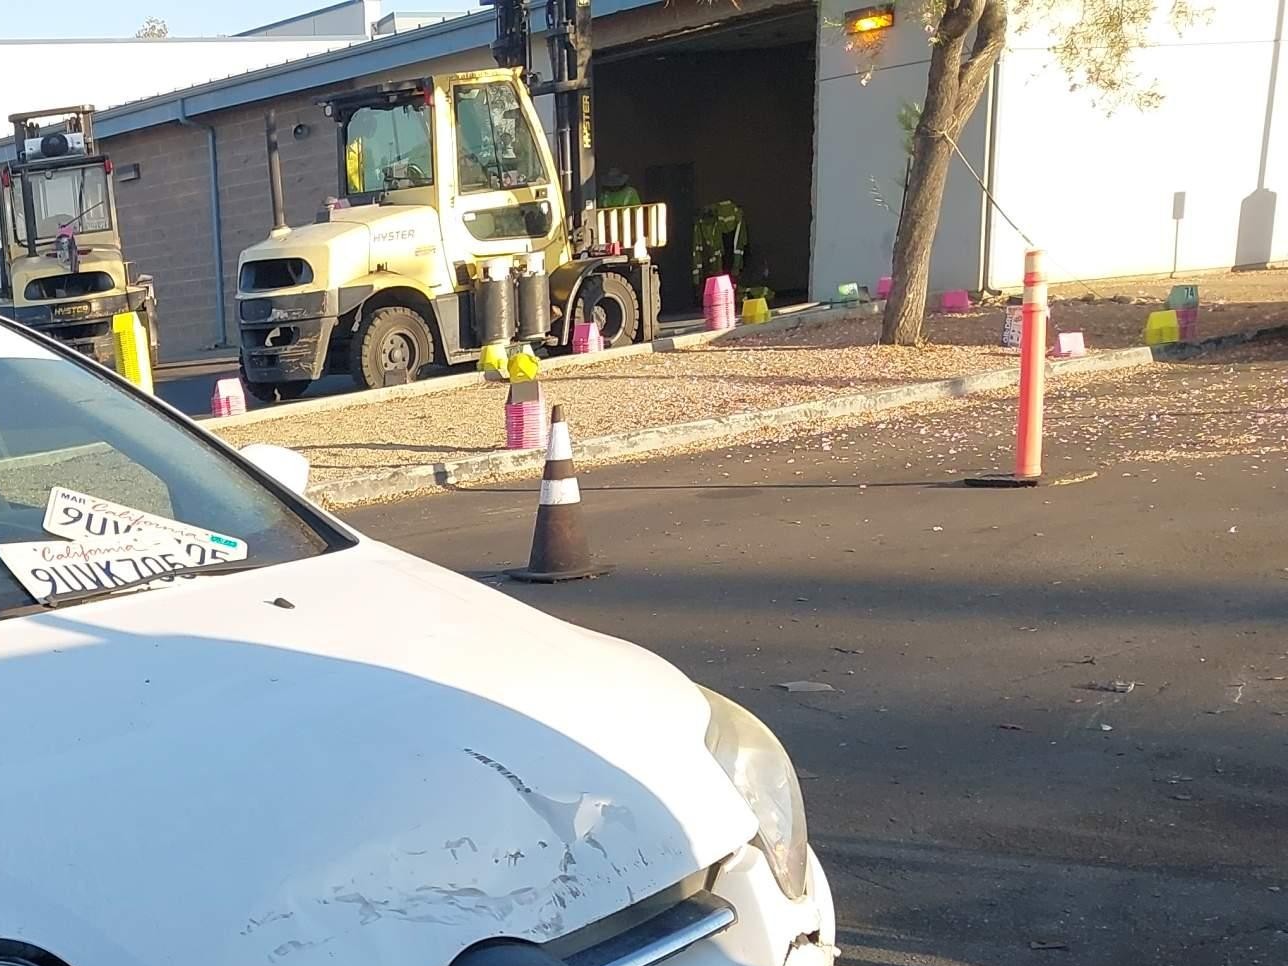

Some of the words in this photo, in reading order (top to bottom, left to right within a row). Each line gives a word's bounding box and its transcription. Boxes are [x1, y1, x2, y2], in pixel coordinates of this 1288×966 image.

[582, 95, 593, 148] HYSTER
[373, 229, 416, 243] HYSTER
[1184, 287, 1195, 299] 74
[54, 305, 89, 316] HYSTER
[91, 502, 201, 540] California
[41, 542, 142, 563] California
